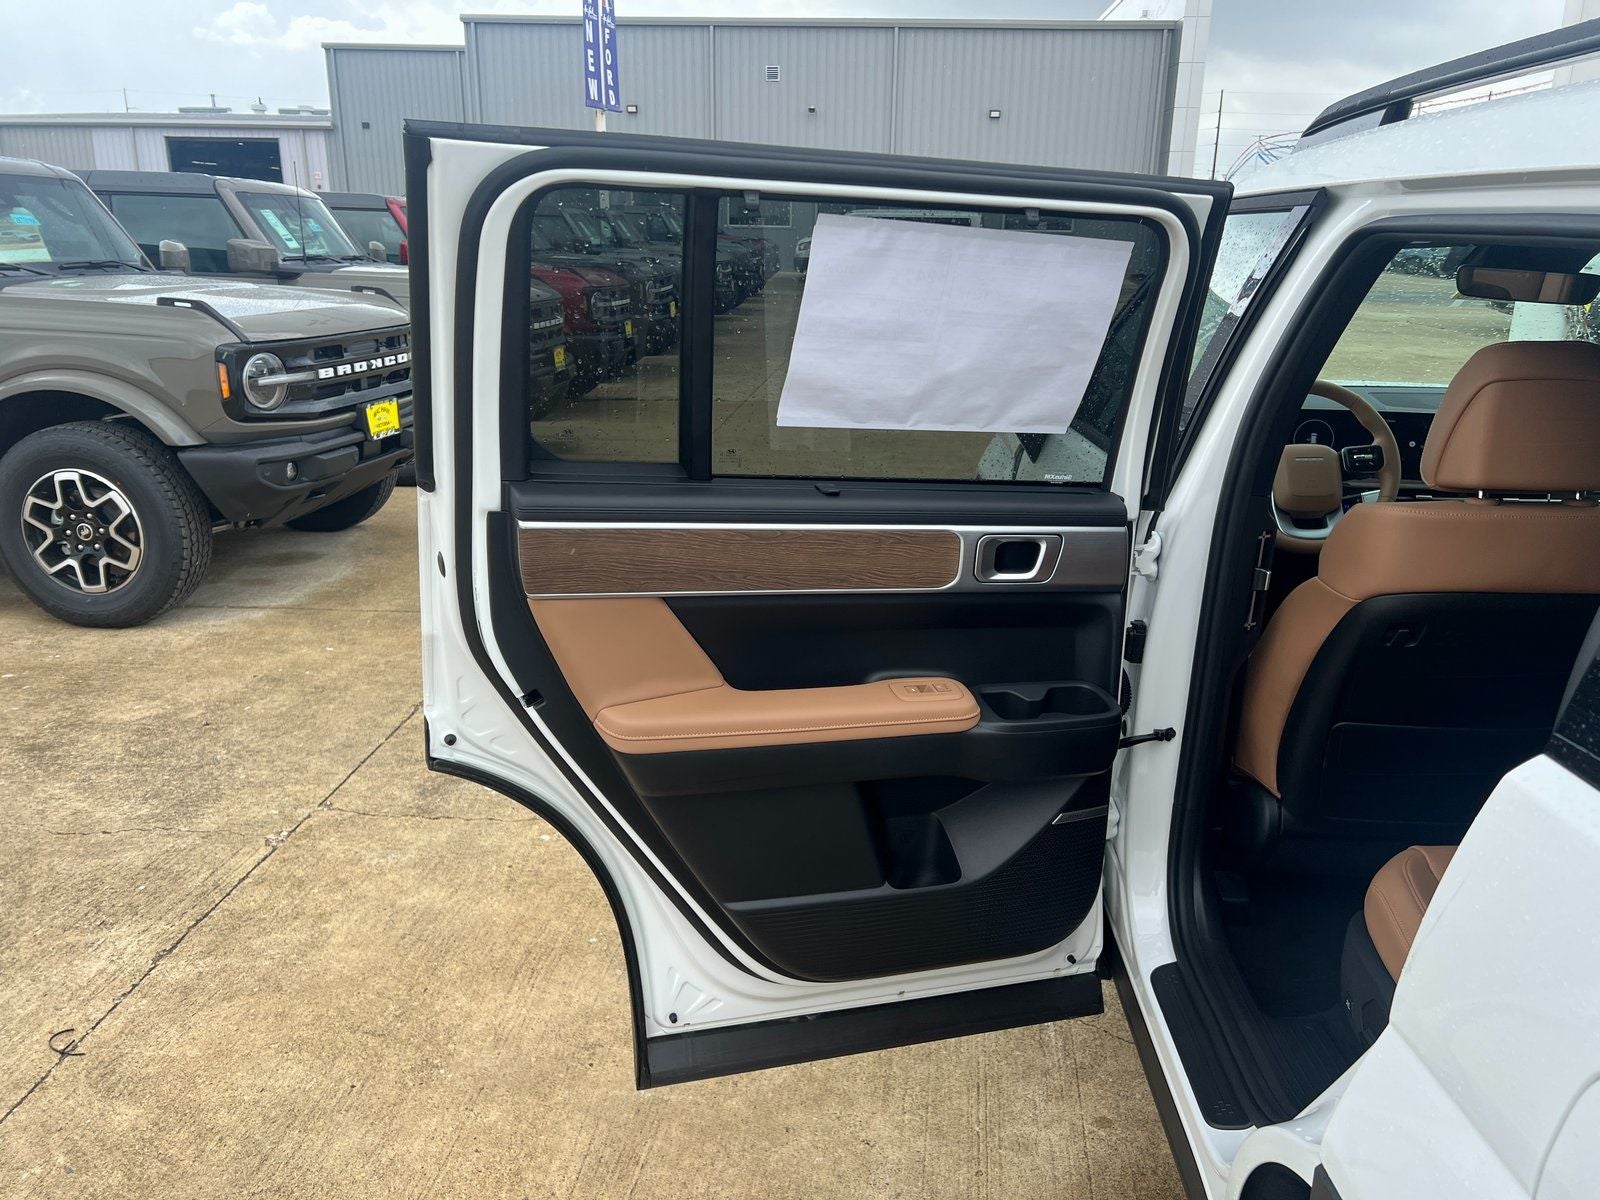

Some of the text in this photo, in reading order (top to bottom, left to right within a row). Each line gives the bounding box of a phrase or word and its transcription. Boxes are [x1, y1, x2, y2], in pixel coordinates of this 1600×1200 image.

[585, 19, 598, 101] NEW
[604, 28, 616, 106] FORD
[318, 353, 408, 379] BRONCO
